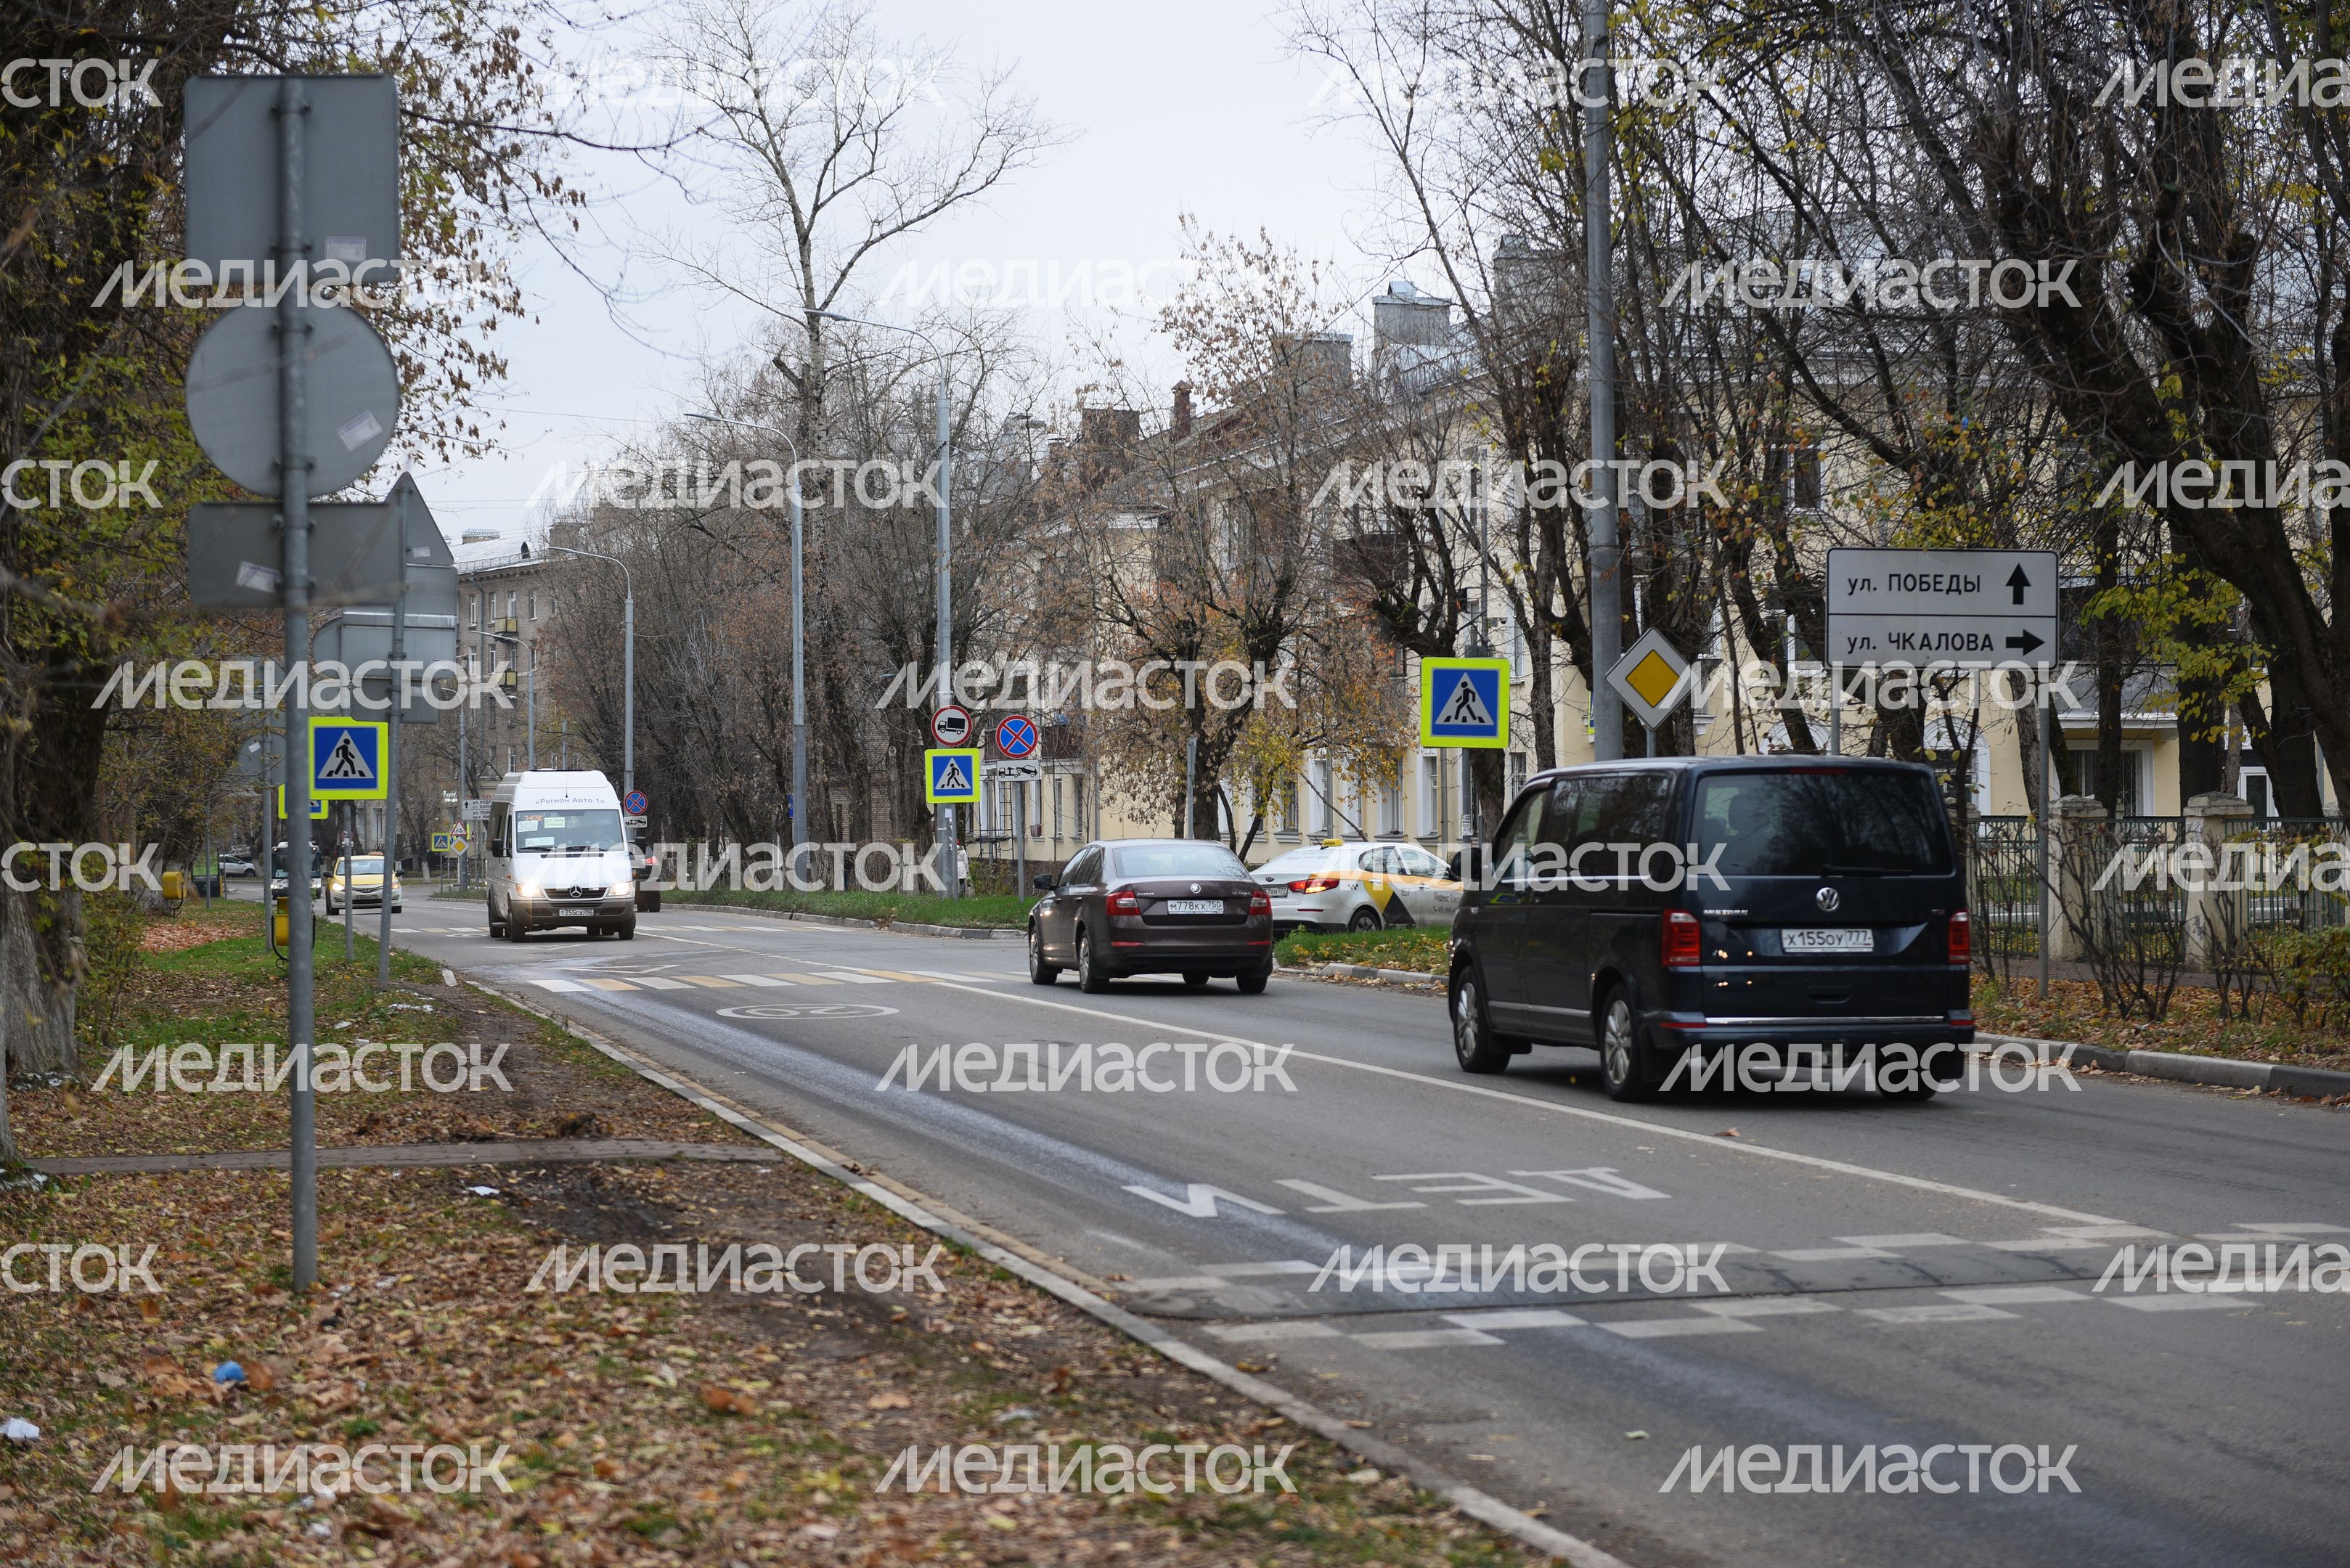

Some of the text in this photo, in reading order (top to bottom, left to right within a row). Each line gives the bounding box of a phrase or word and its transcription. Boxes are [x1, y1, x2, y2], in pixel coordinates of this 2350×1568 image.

[1848, 573, 1980, 596] ул. ПОБЕДЫ
[1848, 632, 1994, 654] ул. ЧКАЛОВА
[1846, 930, 1868, 942] 777
